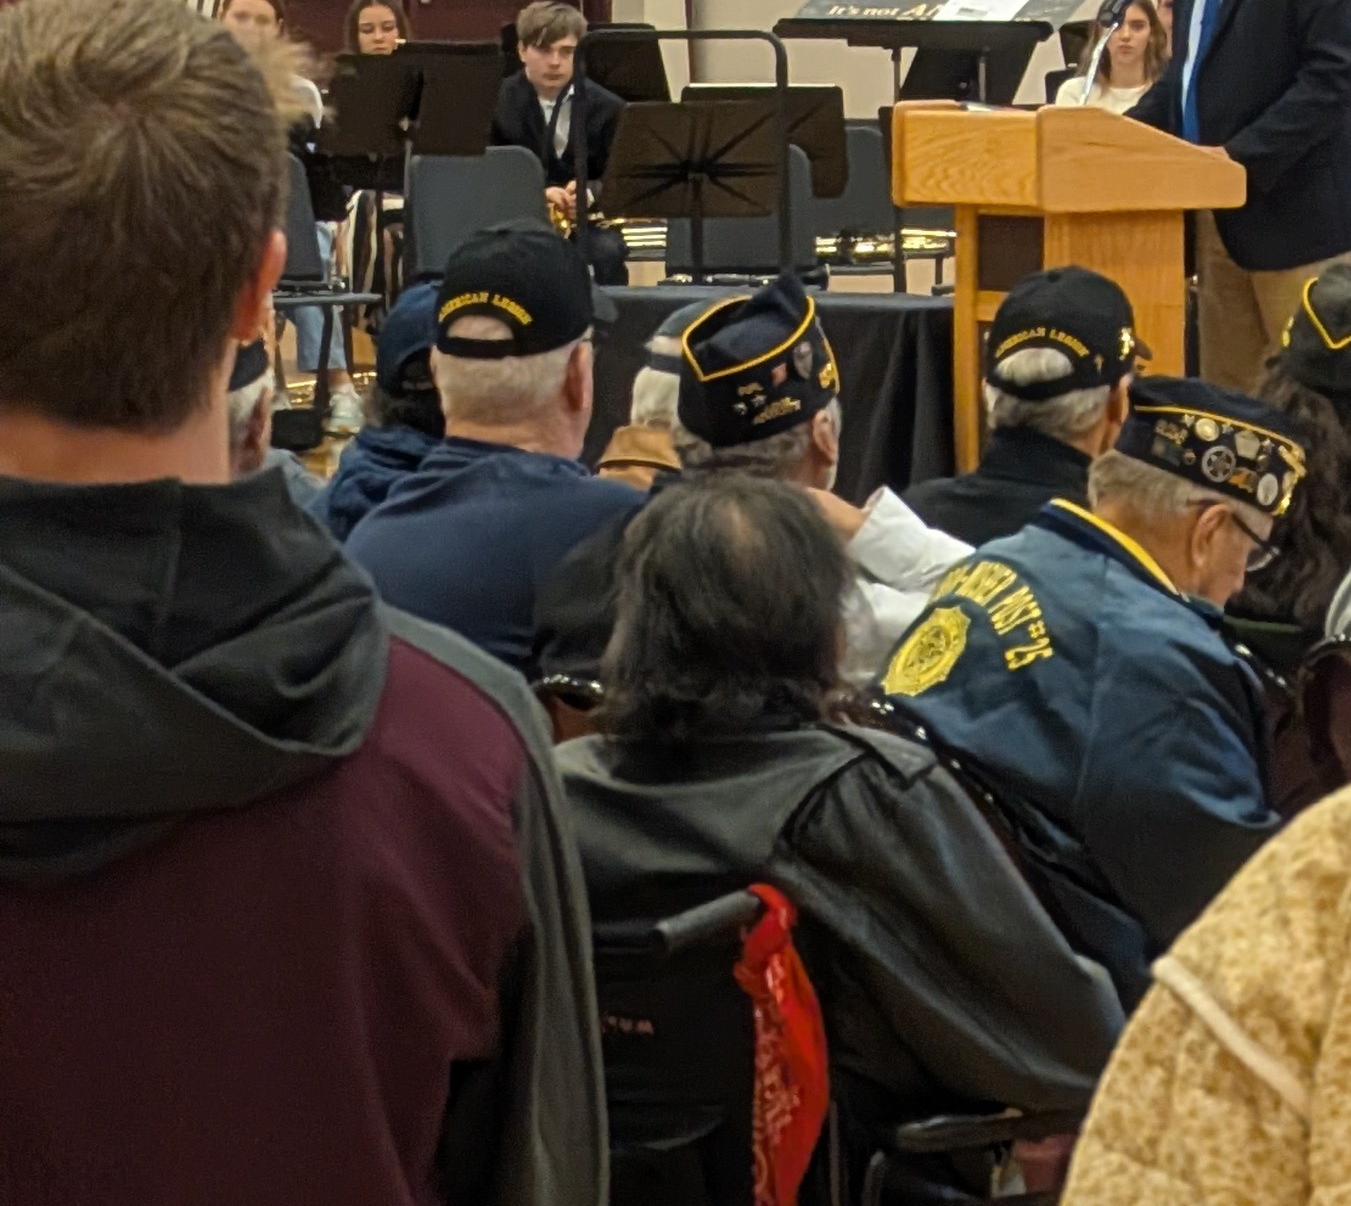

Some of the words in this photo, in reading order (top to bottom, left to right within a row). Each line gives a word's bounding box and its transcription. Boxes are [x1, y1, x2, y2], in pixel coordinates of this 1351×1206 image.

[829, 5, 860, 16] It's
[863, 6, 900, 16] not
[987, 584, 1042, 636] POST
